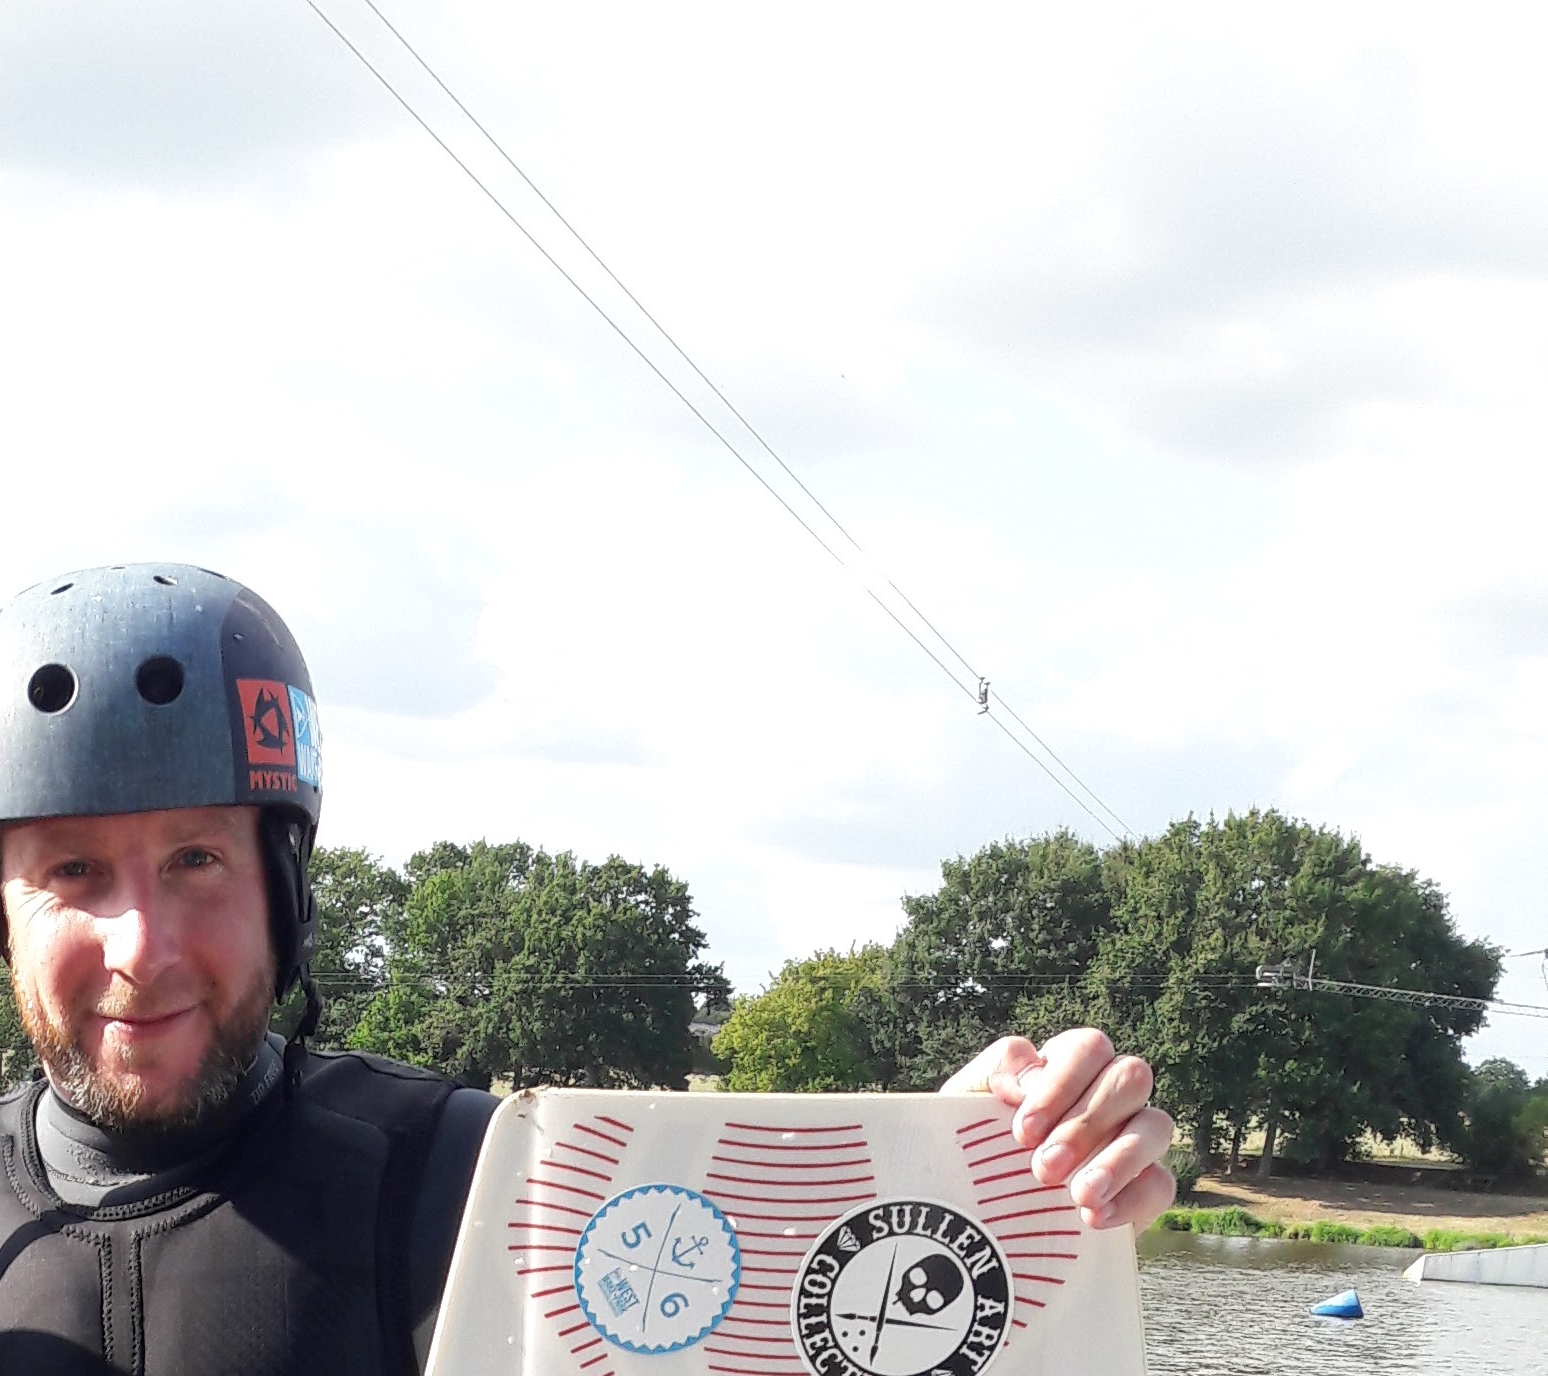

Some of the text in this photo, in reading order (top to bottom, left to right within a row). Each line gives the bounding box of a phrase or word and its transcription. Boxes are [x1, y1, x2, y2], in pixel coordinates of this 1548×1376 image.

[621, 1221, 652, 1249] 5
[868, 1205, 999, 1280] SULLEN
[959, 1295, 1005, 1373] ART
[660, 1292, 689, 1319] 6
